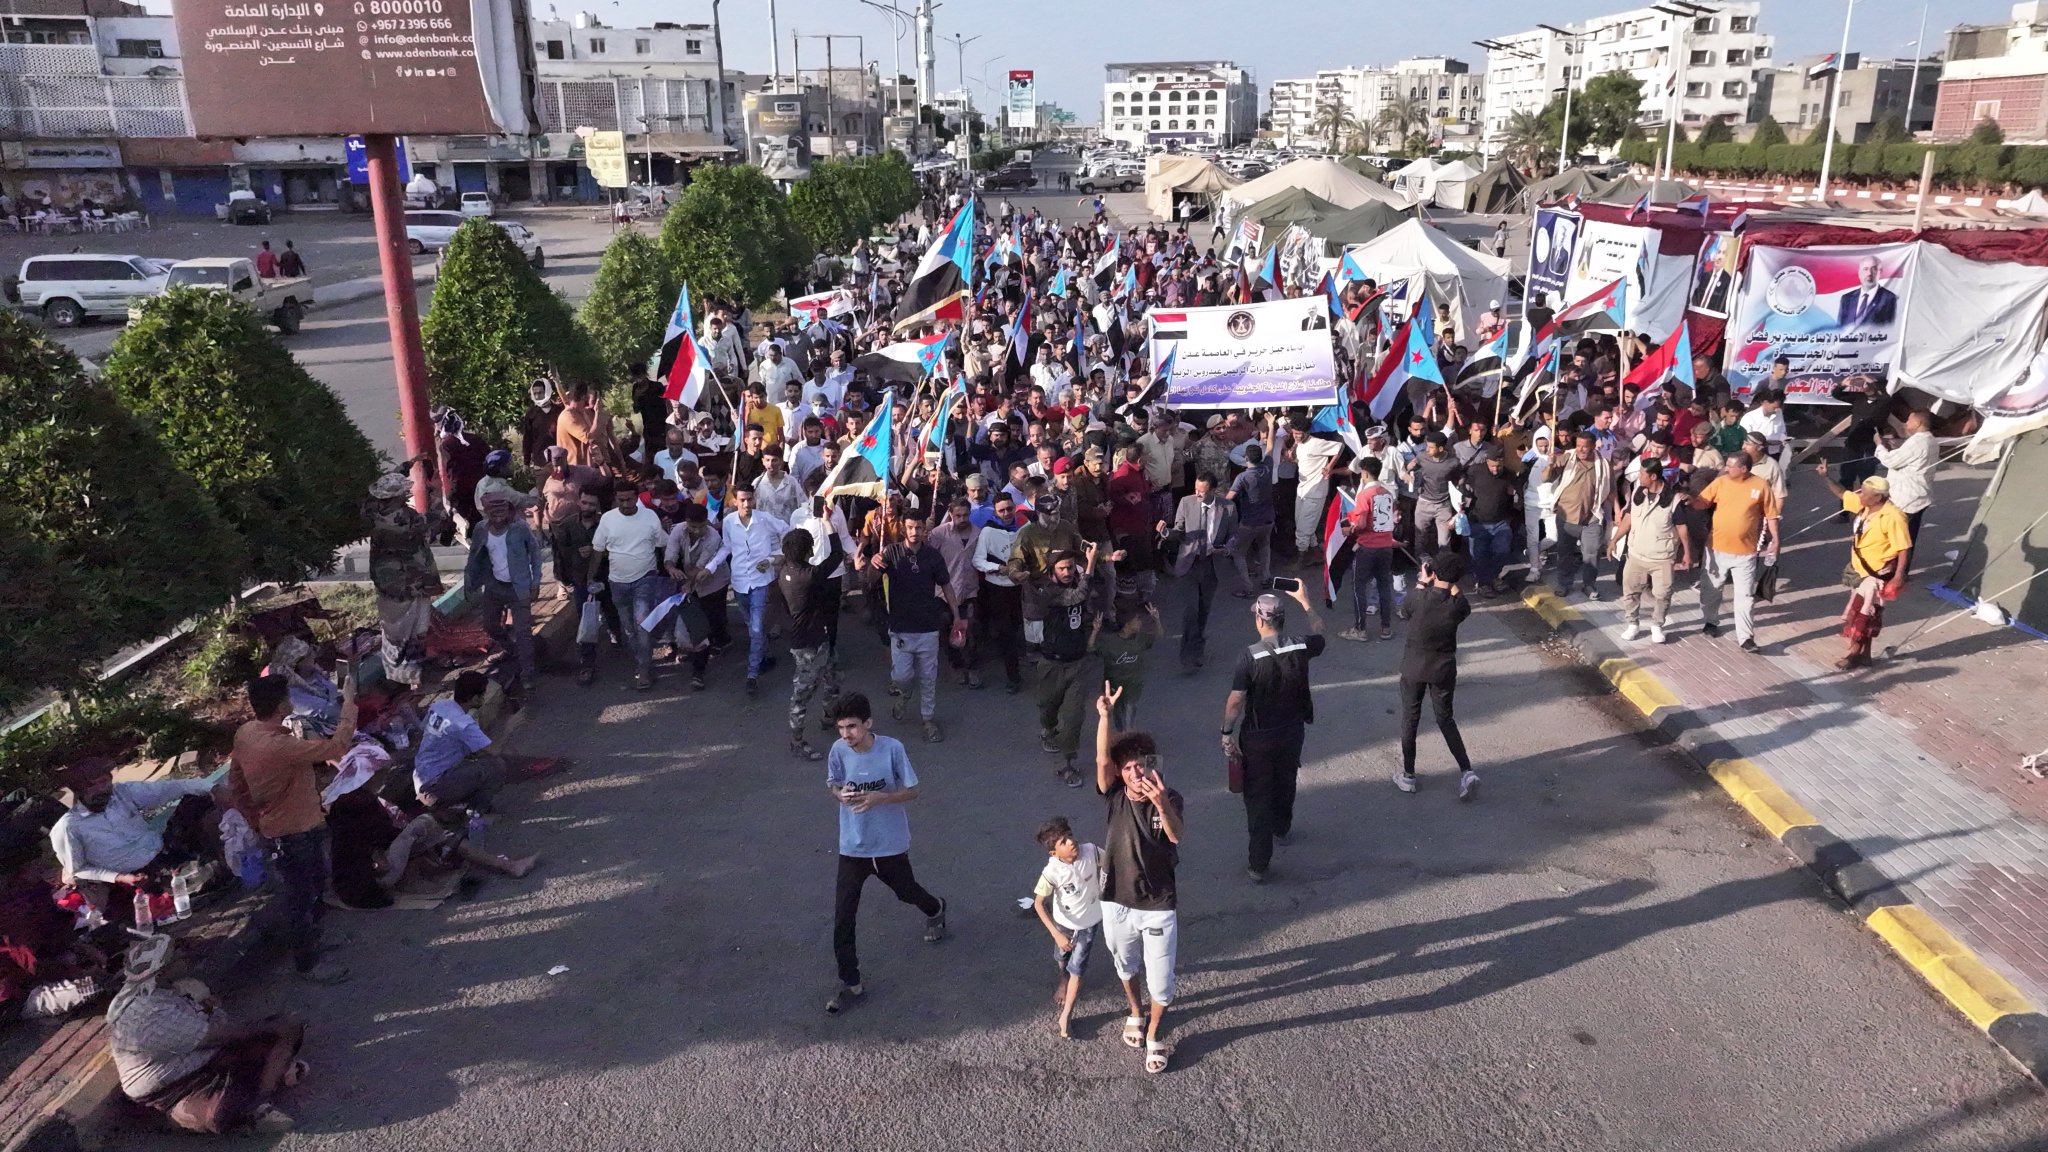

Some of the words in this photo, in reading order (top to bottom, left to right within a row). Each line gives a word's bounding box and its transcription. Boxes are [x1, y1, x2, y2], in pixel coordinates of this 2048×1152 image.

[225, 3, 268, 17] العامة
[271, 3, 310, 20] الإدارة
[370, 0, 443, 14] 8000010
[371, 19, 397, 30] +967
[407, 19, 428, 29] 396
[430, 18, 452, 29] 666
[206, 25, 257, 39] الإسلامي
[260, 26, 287, 36] عدن
[289, 25, 312, 36] بنك
[314, 25, 344, 36] مبنى
[204, 39, 260, 52] المنصورة
[314, 38, 344, 51] شارع
[375, 48, 477, 58] www.adenbank.co
[259, 55, 296, 66] عدن
[1202, 349, 1232, 357] العاصمة
[1233, 347, 1246, 359] في
